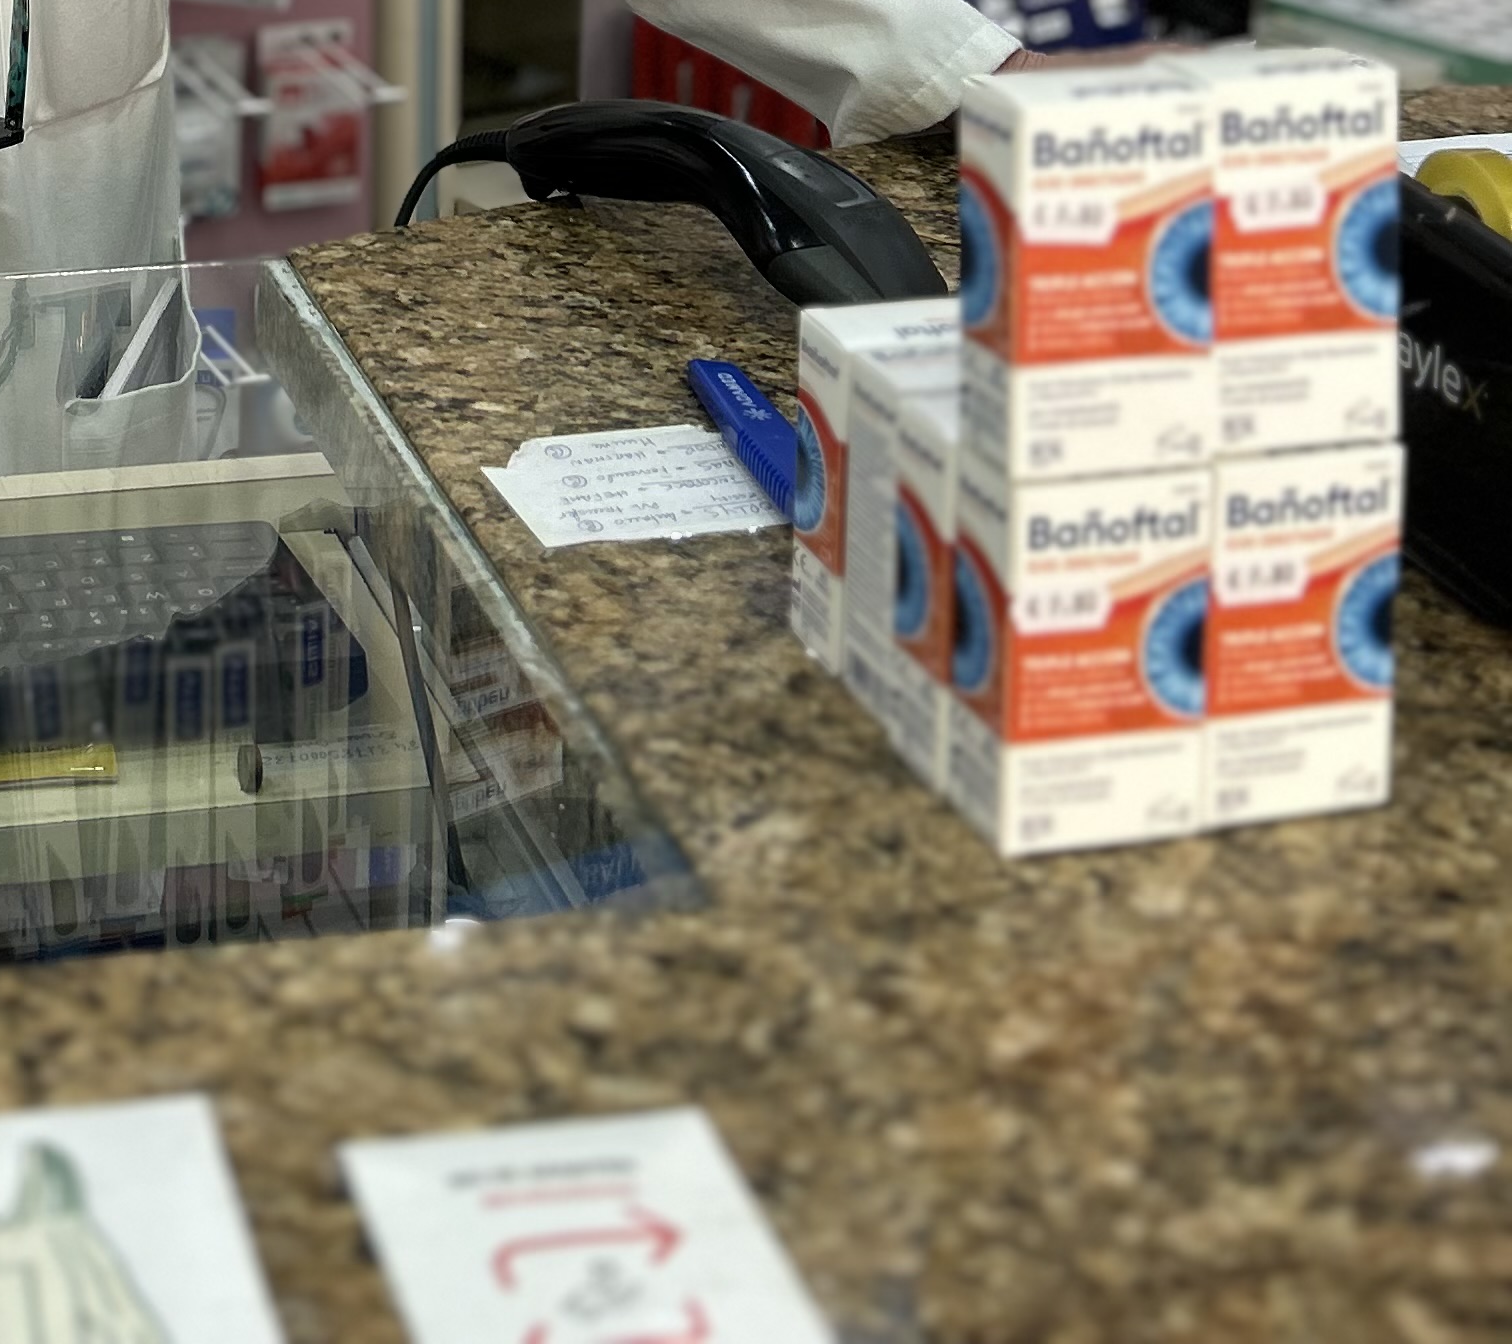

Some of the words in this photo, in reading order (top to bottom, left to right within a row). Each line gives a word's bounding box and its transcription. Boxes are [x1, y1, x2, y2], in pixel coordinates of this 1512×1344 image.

[1031, 122, 1206, 169] Bañoftal
[1220, 99, 1387, 146] Bañoftal
[1028, 500, 1200, 551] Bañoftal
[1225, 475, 1391, 529] Bañoftal
